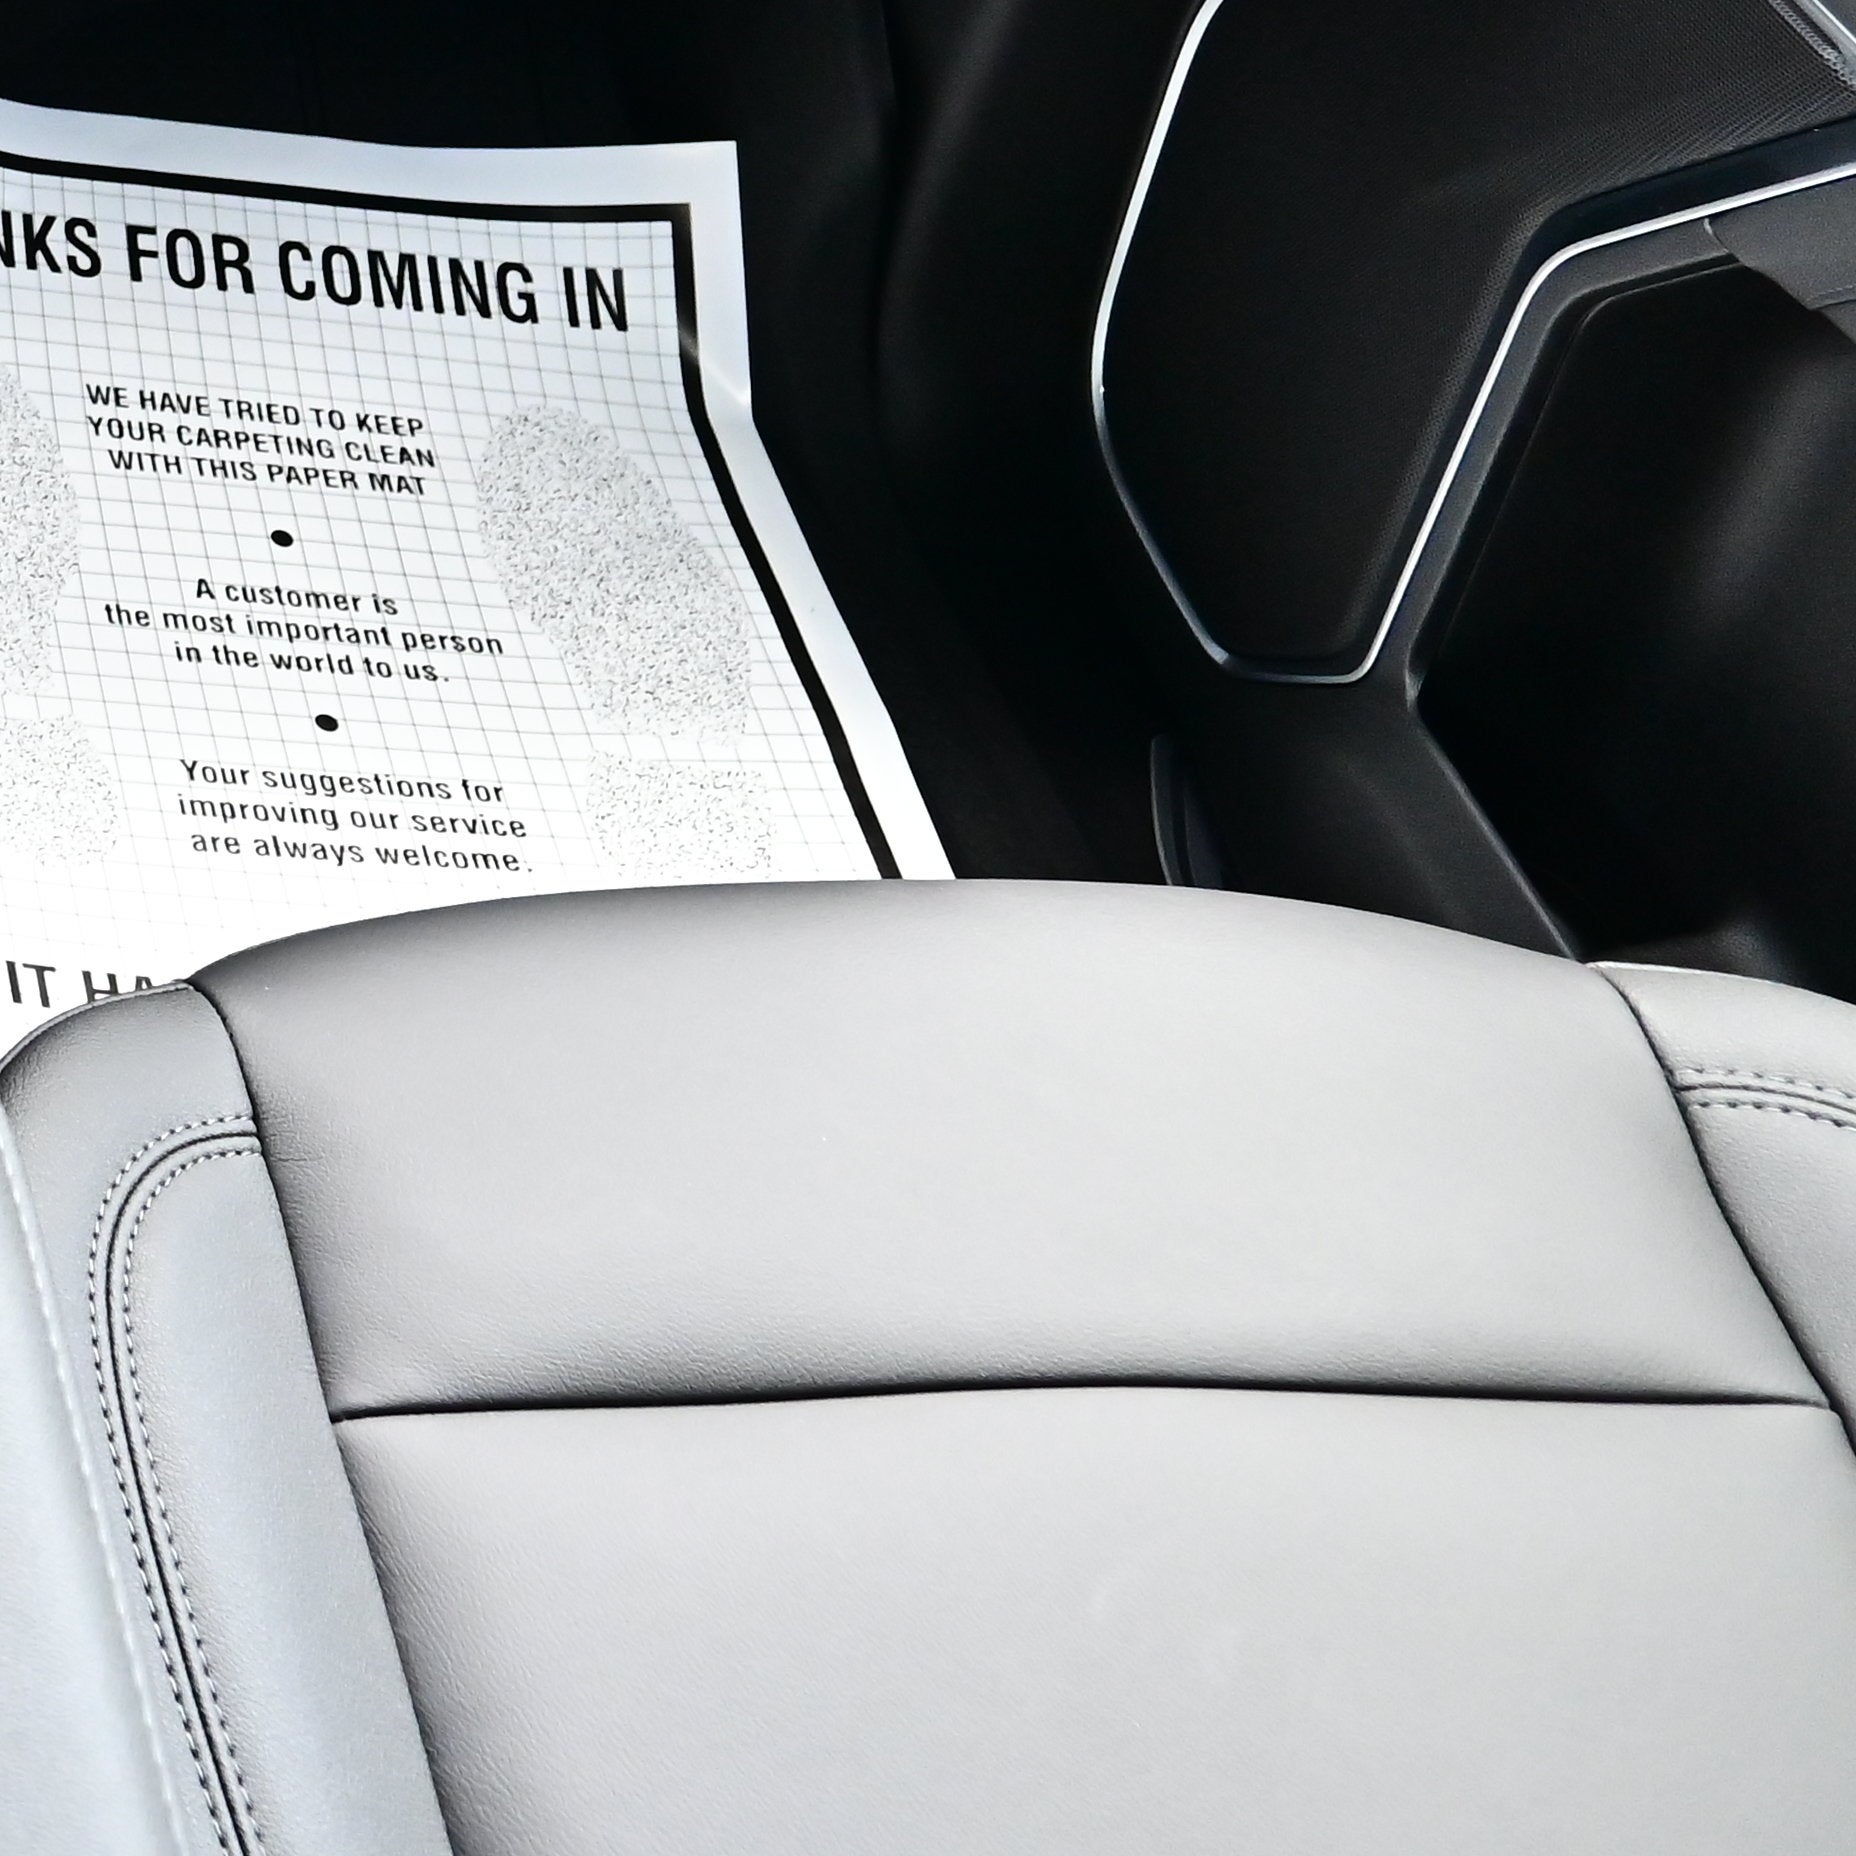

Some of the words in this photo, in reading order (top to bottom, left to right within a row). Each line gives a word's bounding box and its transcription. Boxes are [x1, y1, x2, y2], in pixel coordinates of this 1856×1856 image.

[126, 224, 255, 295] FOR
[278, 239, 539, 325] COMING
[562, 265, 628, 333] IN
[86, 383, 129, 409] WE
[139, 389, 211, 417] HAVE
[219, 397, 301, 426] TRIED
[310, 406, 346, 431] TO
[356, 412, 425, 438] KEEP
[87, 415, 167, 444] YOUR
[176, 424, 336, 459] CARPETING
[345, 441, 436, 469] CLEAN
[107, 448, 183, 476] WITH
[191, 456, 258, 483] THIS
[267, 463, 360, 491] PAPER
[369, 472, 427, 496] MAT
[195, 577, 216, 601] A
[225, 583, 363, 613] customer
[372, 593, 400, 617] is
[104, 603, 151, 629] the
[162, 611, 237, 635] most
[245, 614, 394, 647] important
[401, 629, 505, 656] person
[174, 641, 202, 664] in
[212, 643, 259, 669] the
[269, 650, 355, 677] world
[363, 656, 394, 680] to
[404, 662, 451, 683] us.
[180, 759, 250, 786] Your
[261, 768, 453, 802] suggestions
[462, 779, 504, 804] for
[178, 793, 340, 832] improving
[350, 809, 400, 830] our
[411, 811, 528, 839] service
[191, 832, 241, 855] are
[254, 835, 365, 867] always
[375, 845, 534, 873] welcome.
[5, 960, 57, 1009] IT
